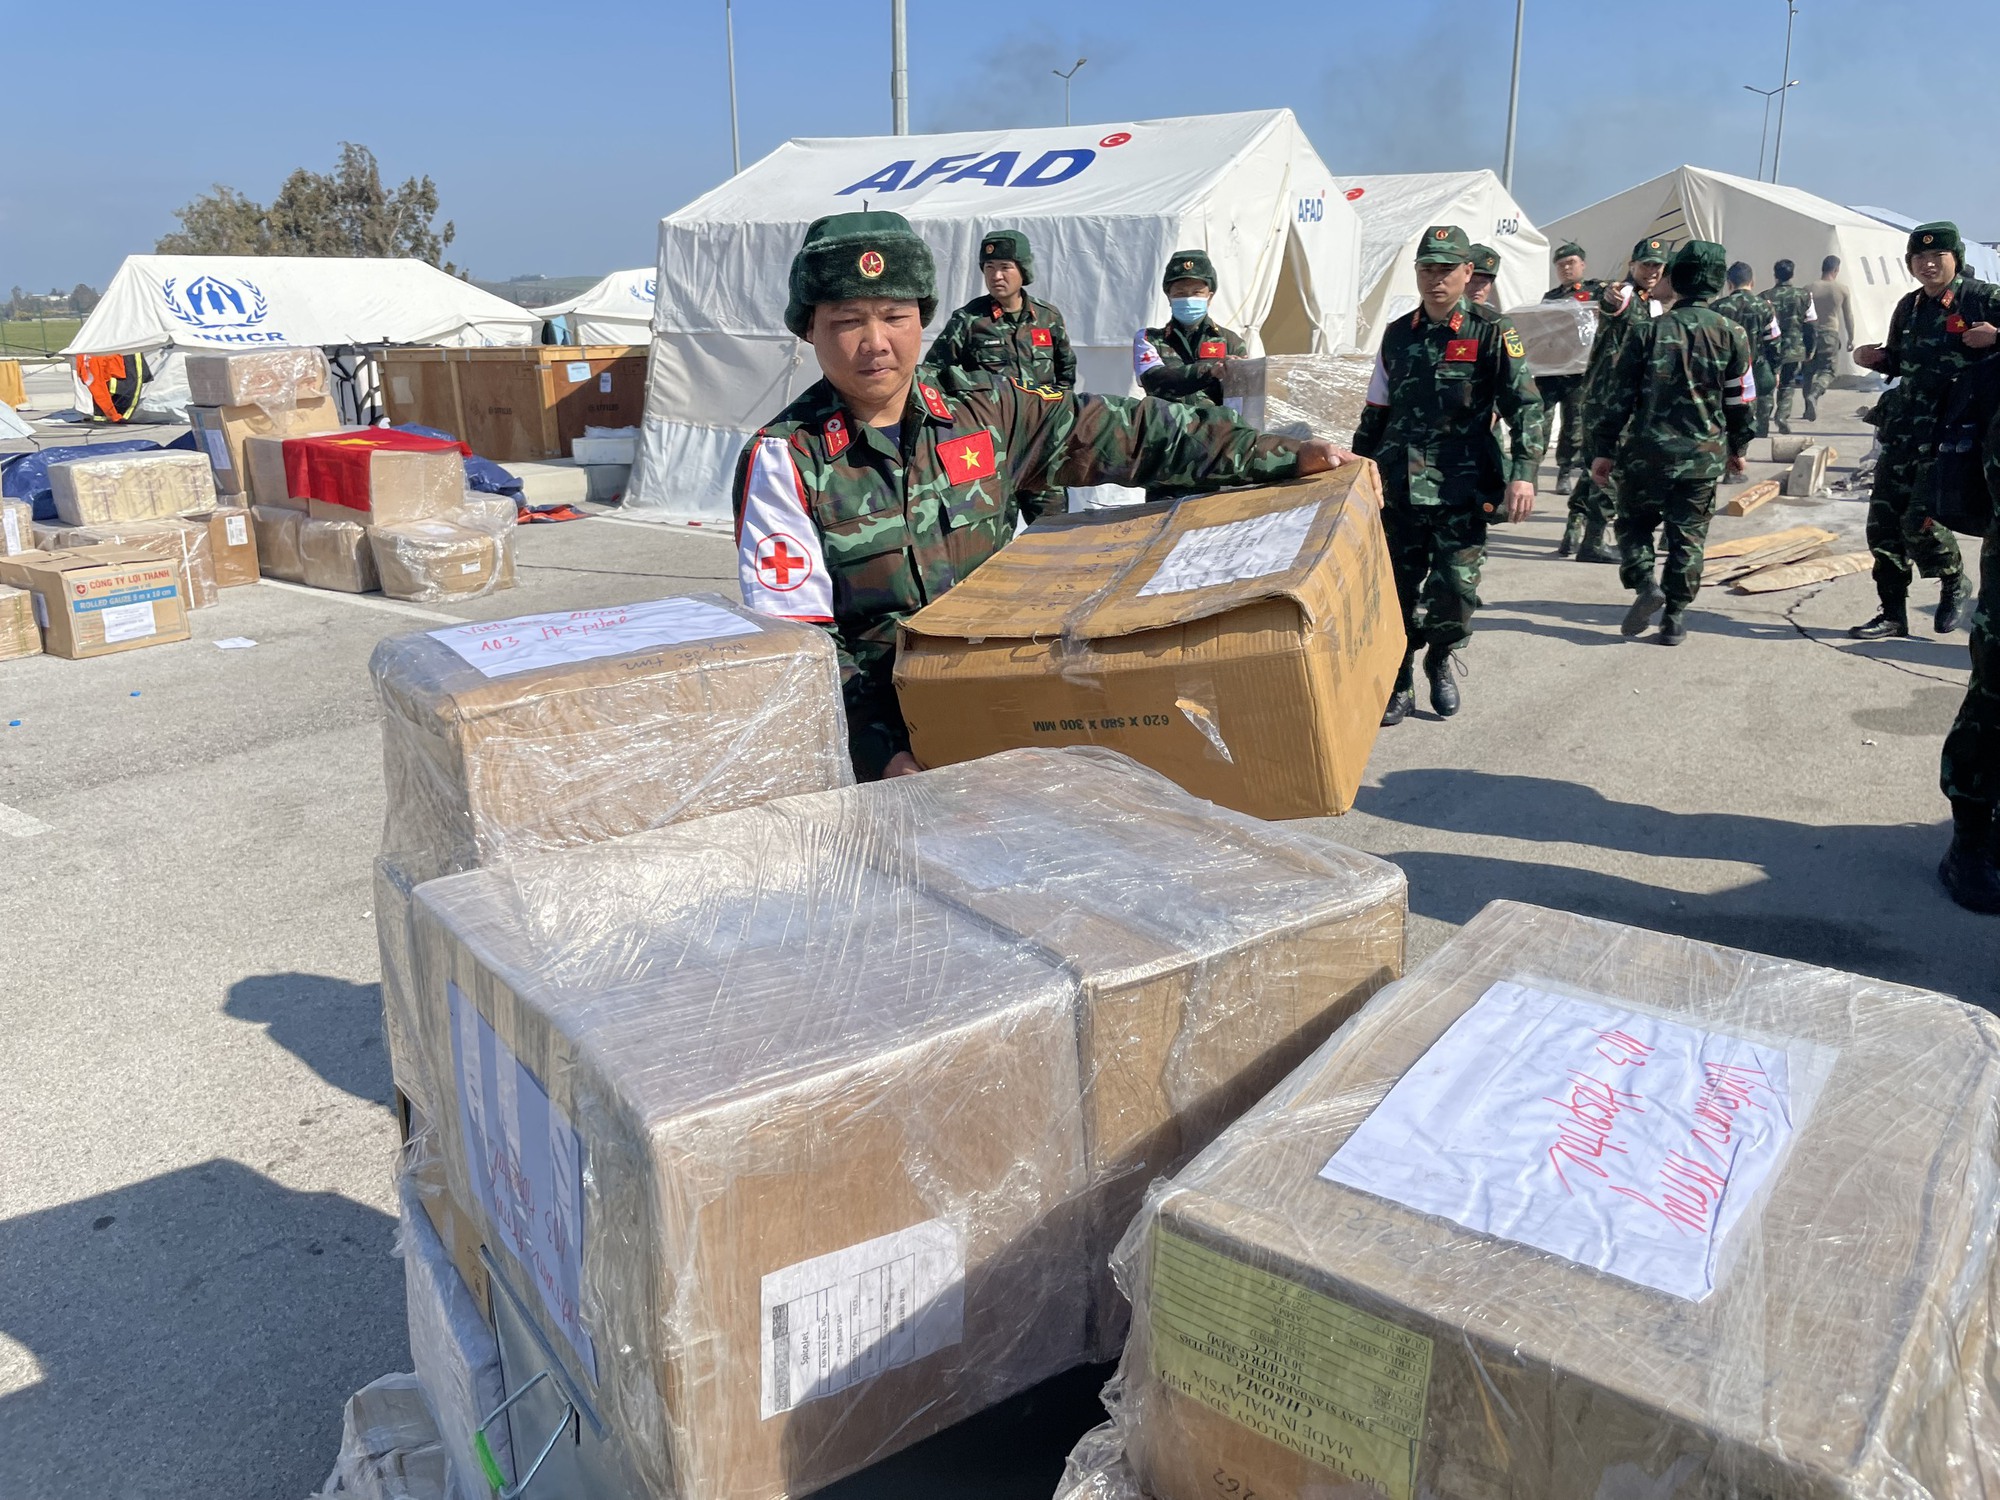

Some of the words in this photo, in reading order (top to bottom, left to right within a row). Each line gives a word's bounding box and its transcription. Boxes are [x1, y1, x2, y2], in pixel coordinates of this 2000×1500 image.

[833, 148, 1097, 196] AFAD
[1297, 198, 1323, 223] AFAD
[1495, 218, 1519, 237] AFAD
[193, 331, 288, 343] NHCR
[115, 576, 125, 585] TY
[144, 569, 170, 581] THANH
[80, 598, 108, 610] ROLLED
[1032, 720, 1057, 732] MM
[1060, 719, 1085, 731] 300
[1101, 717, 1126, 729] 580
[1142, 714, 1170, 726] 620
[1373, 1323, 1427, 1351] QUANTITY
[800, 1331, 809, 1366] SpiceJet
[1179, 1333, 1239, 1367] CATHETERS
[1249, 1341, 1289, 1365] ML/CC
[1349, 1338, 1425, 1374] STERILISATION
[1387, 1342, 1425, 1363] EXPIRY
[1241, 1363, 1275, 1386] FOLEY
[1252, 1354, 1287, 1378] CH/FR
[1292, 1359, 1305, 1372] 30
[1383, 1365, 1399, 1379] NO
[1290, 1372, 1301, 1385] 16
[1193, 1370, 1276, 1421] MALAYSIA
[1236, 1373, 1313, 1418] CHROMA
[1278, 1380, 1338, 1415] STANDARD
[1281, 1414, 1297, 1432] IN
[1341, 1410, 1365, 1427] WAY
[1234, 1408, 1345, 1473] TECHNOLOGY
[1302, 1423, 1353, 1460] MADE
